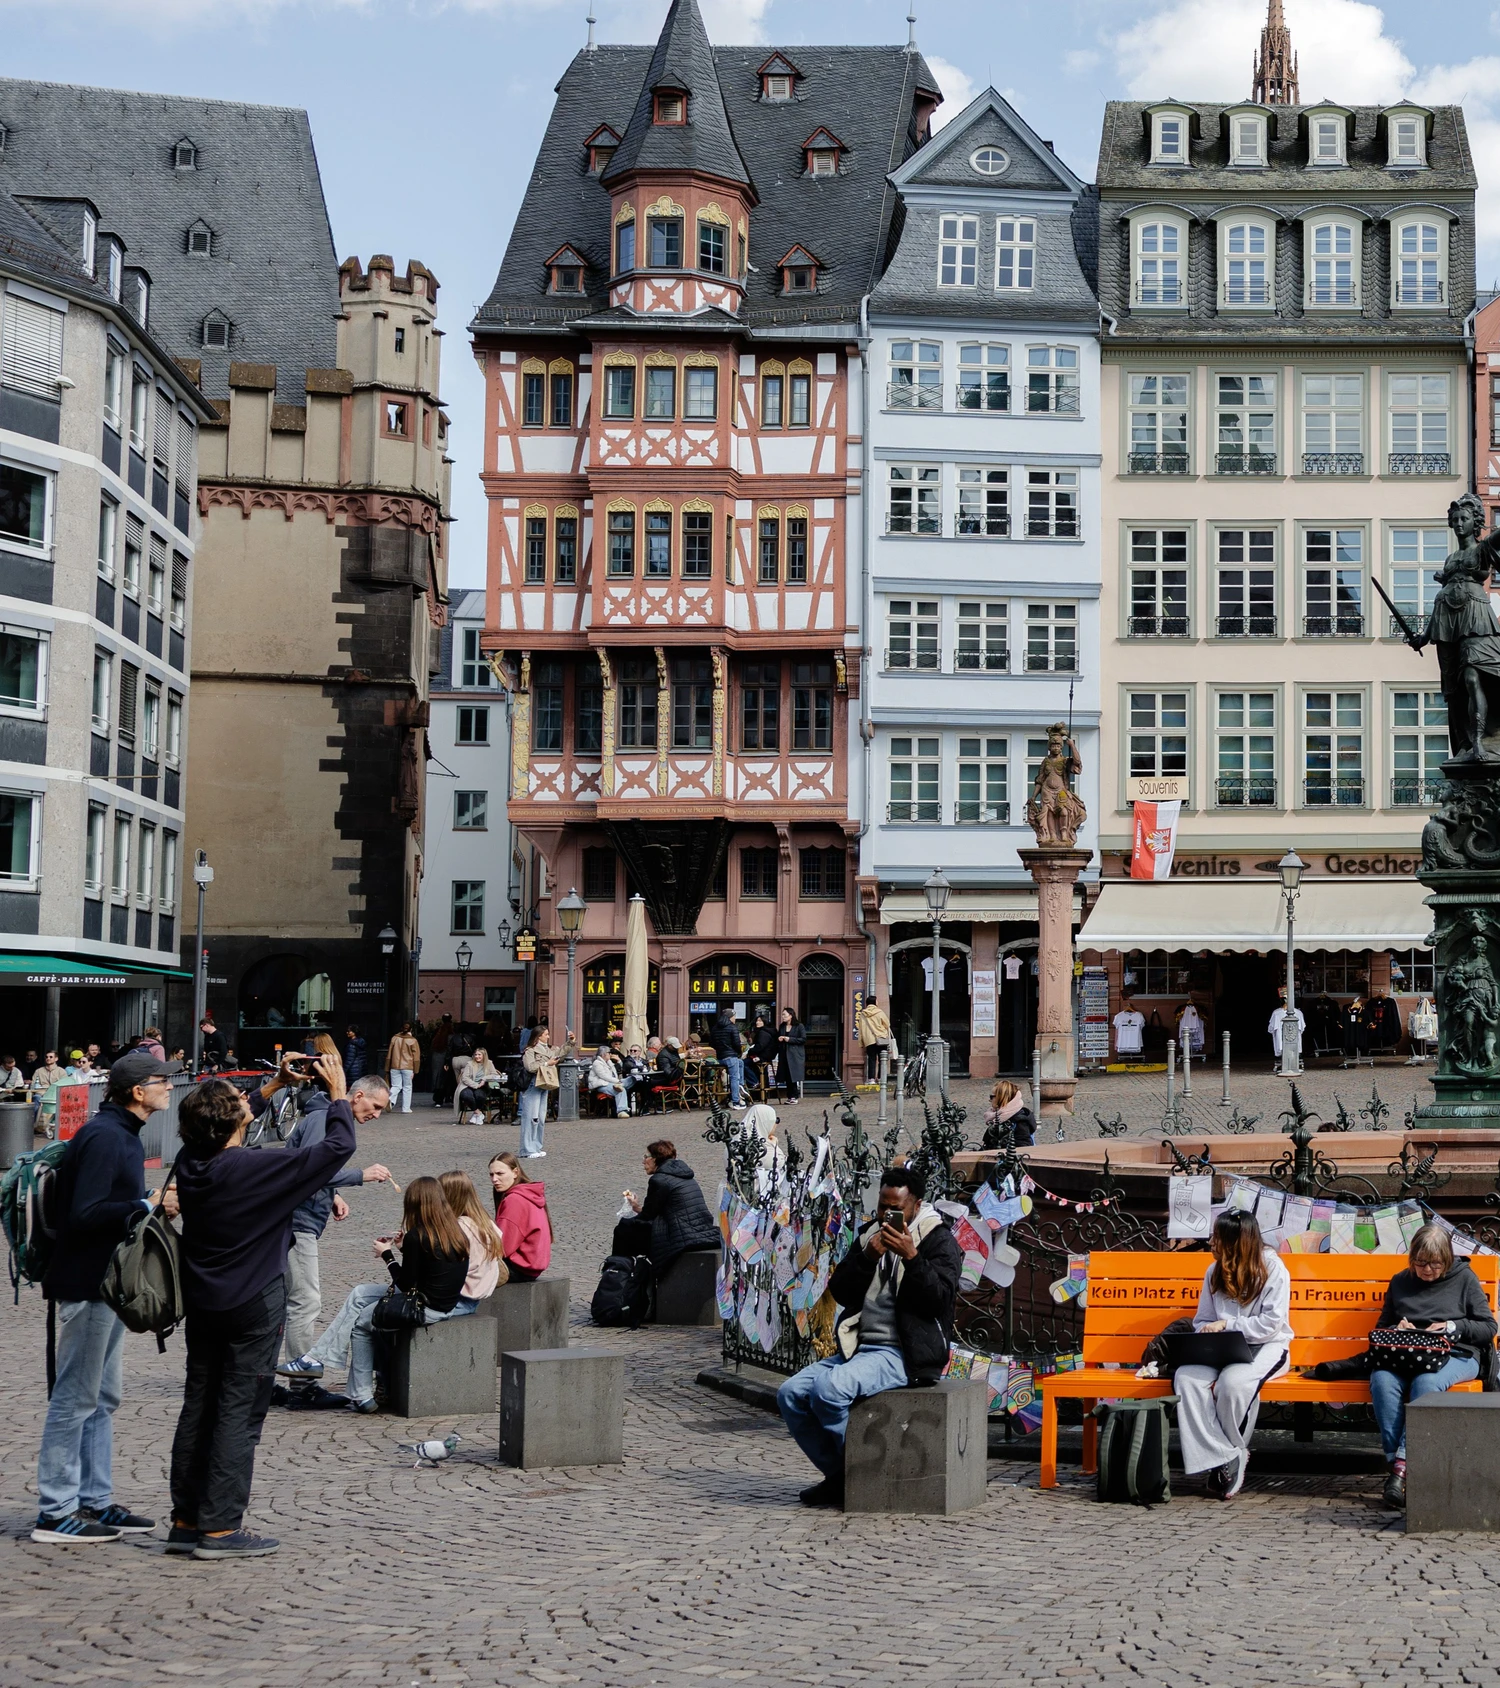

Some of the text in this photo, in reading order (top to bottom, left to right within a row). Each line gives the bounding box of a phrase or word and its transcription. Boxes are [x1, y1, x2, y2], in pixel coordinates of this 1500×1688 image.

[1139, 779, 1178, 795] Souvenirs
[1122, 855, 1241, 876] Svenirs
[982, 910, 1036, 920] Samstagsberg
[27, 974, 56, 983] CAFFÈ
[693, 980, 774, 993] CHANGE
[1092, 1287, 1127, 1298] Kein
[1134, 1287, 1175, 1299] Platz
[1181, 1287, 1202, 1299] fü
[1306, 1289, 1365, 1301] Frauen
